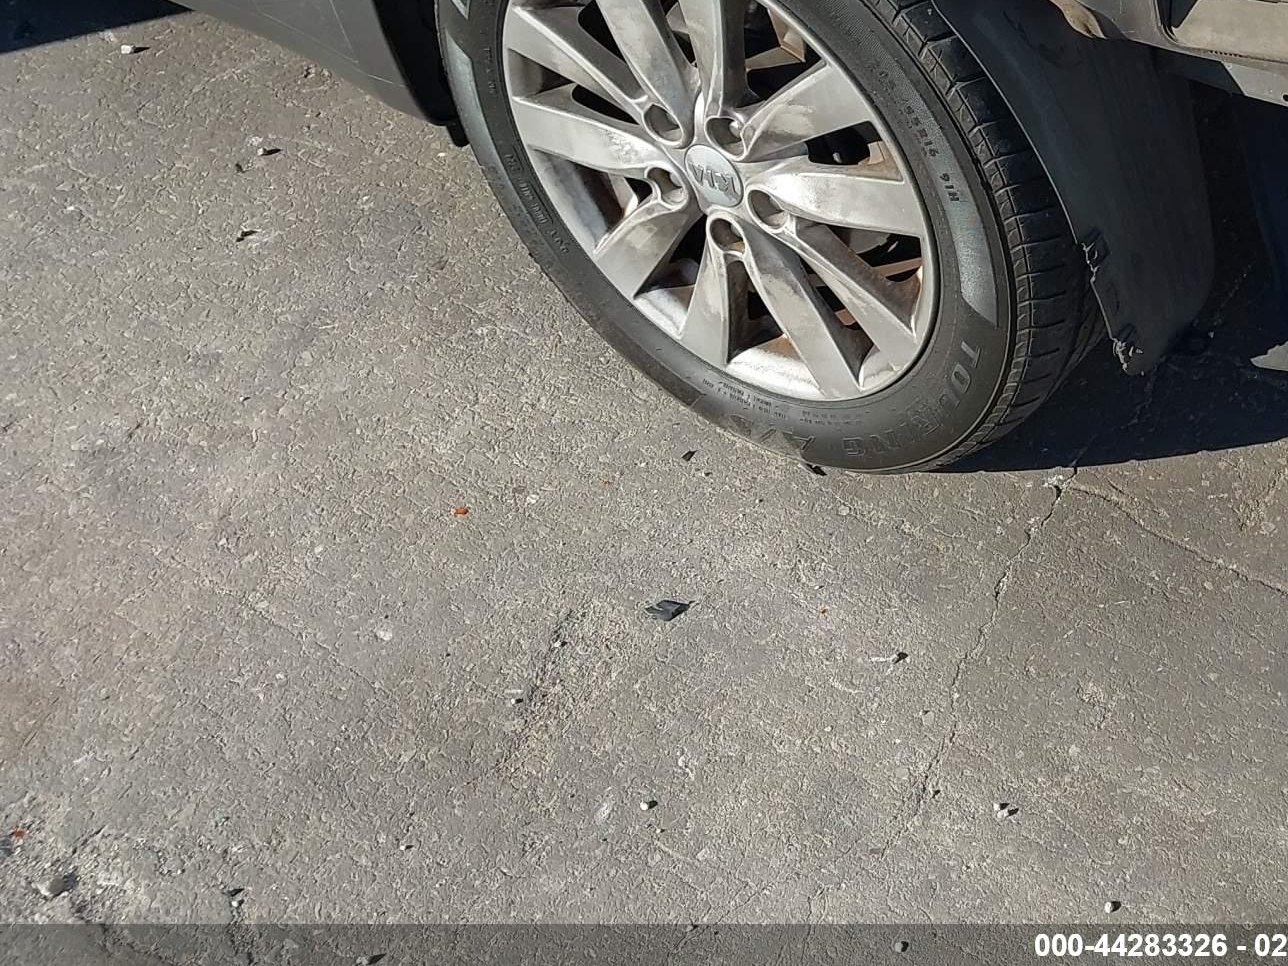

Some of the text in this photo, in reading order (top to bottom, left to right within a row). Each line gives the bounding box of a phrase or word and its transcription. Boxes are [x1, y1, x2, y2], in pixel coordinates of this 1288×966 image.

[690, 163, 740, 201] KIA
[939, 172, 961, 203] 91H
[841, 339, 985, 458] TOURING
